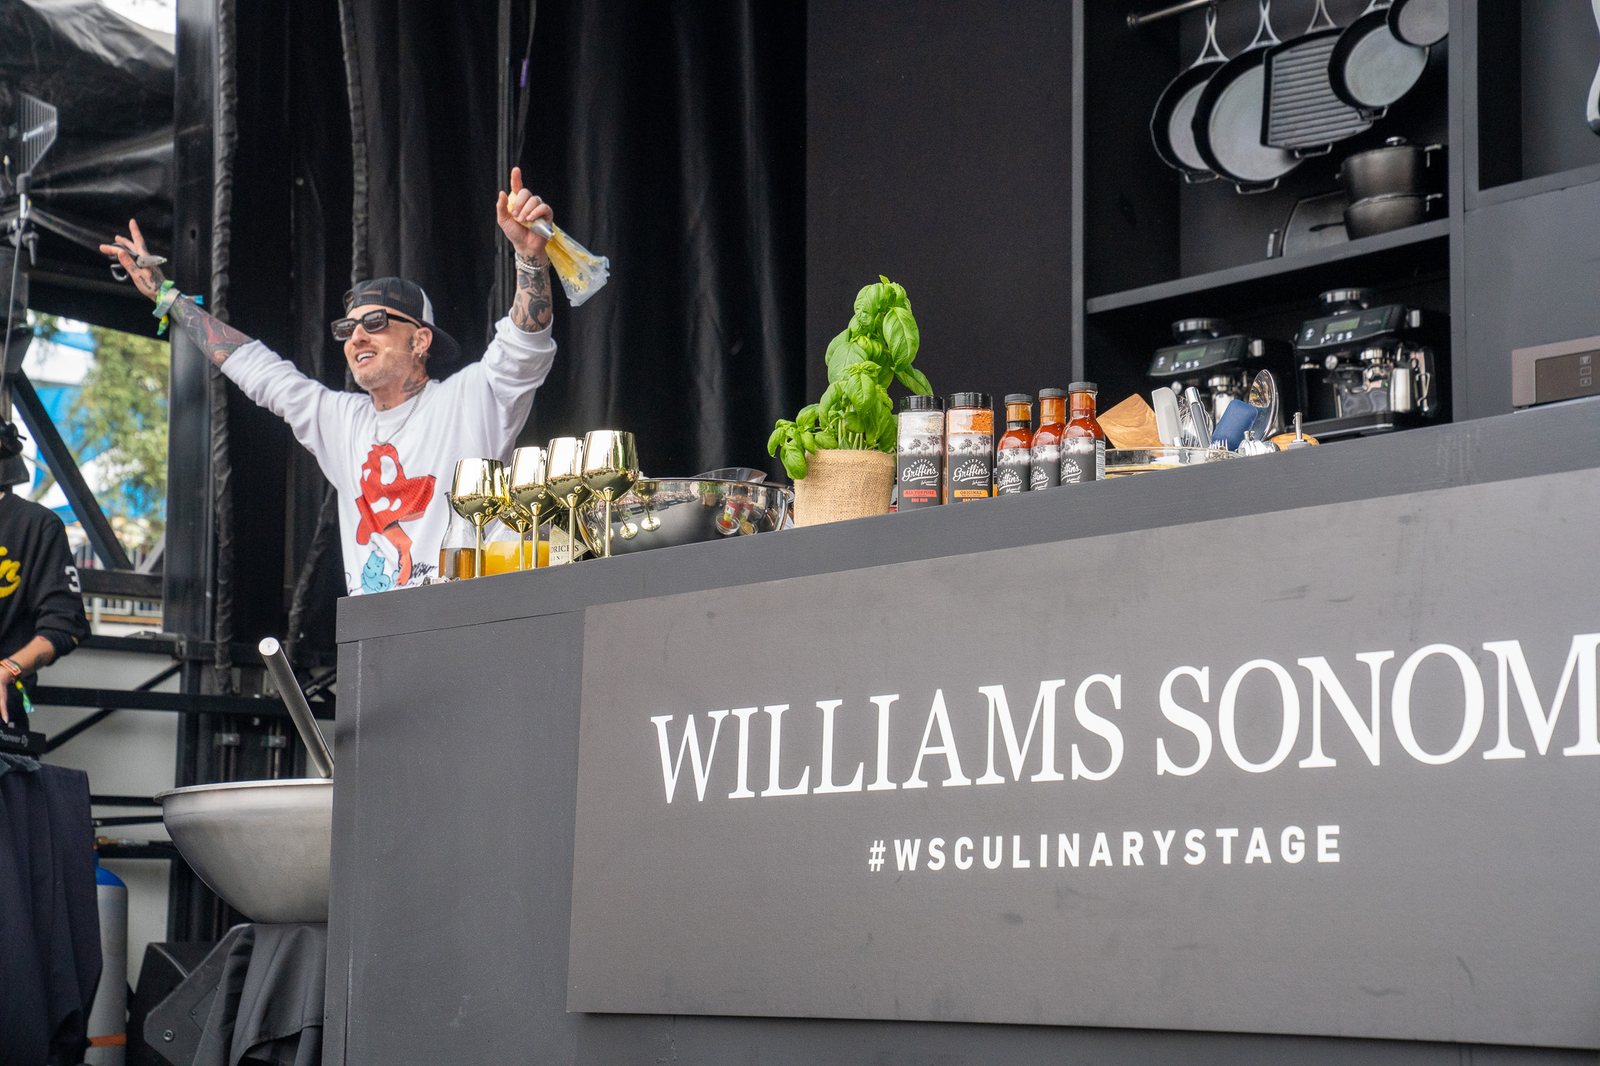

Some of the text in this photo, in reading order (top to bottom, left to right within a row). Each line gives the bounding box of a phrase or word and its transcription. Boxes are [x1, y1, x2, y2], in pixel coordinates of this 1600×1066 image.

[902, 464, 939, 482] Griffin's
[952, 464, 990, 482] Griffin's
[65, 566, 81, 593] 3
[650, 632, 1600, 805] WILLIAMS SONOM
[868, 824, 1341, 872] #WSCULINARYSTAGE
